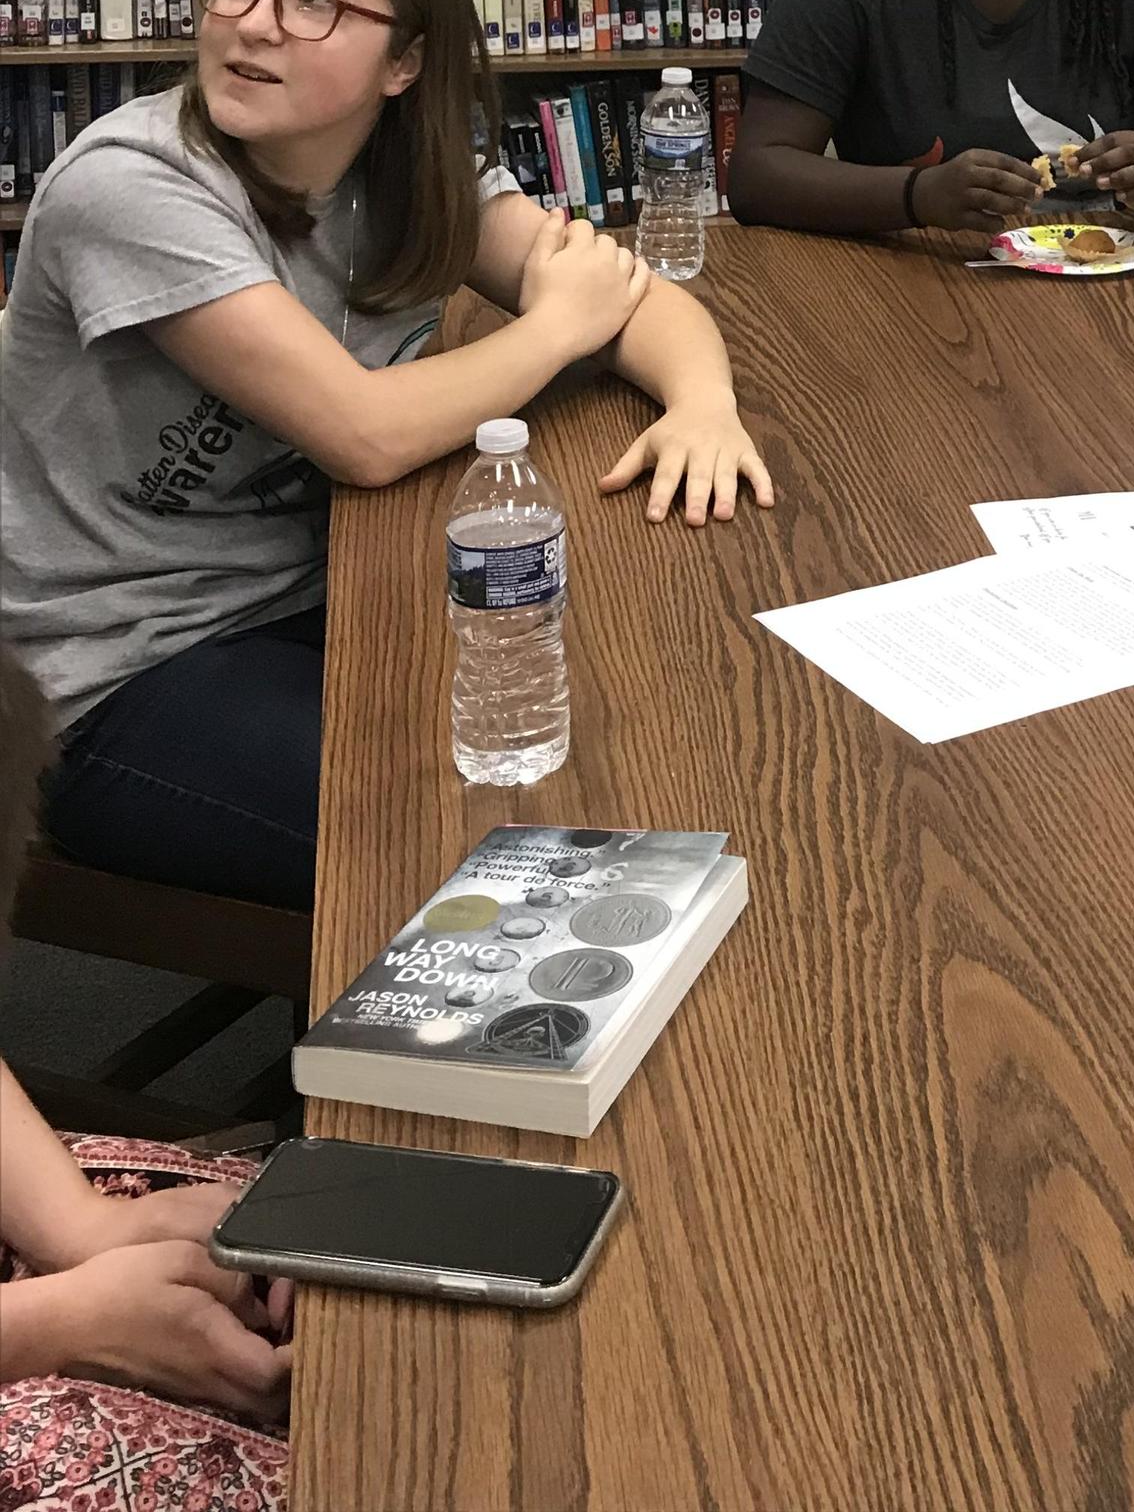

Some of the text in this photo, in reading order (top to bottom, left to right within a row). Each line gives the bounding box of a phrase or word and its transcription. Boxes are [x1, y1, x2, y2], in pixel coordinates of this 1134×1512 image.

[625, 100, 638, 149] MORNING
[597, 101, 617, 178] GOLDEN SON
[158, 393, 219, 454] Disea
[483, 873, 517, 884] tour
[523, 873, 545, 885] de
[383, 951, 456, 969] WAY
[410, 937, 501, 960] LONG
[392, 967, 500, 991] DOWN
[347, 990, 429, 1006] JASON
[355, 1001, 485, 1026] REYNOLDS
